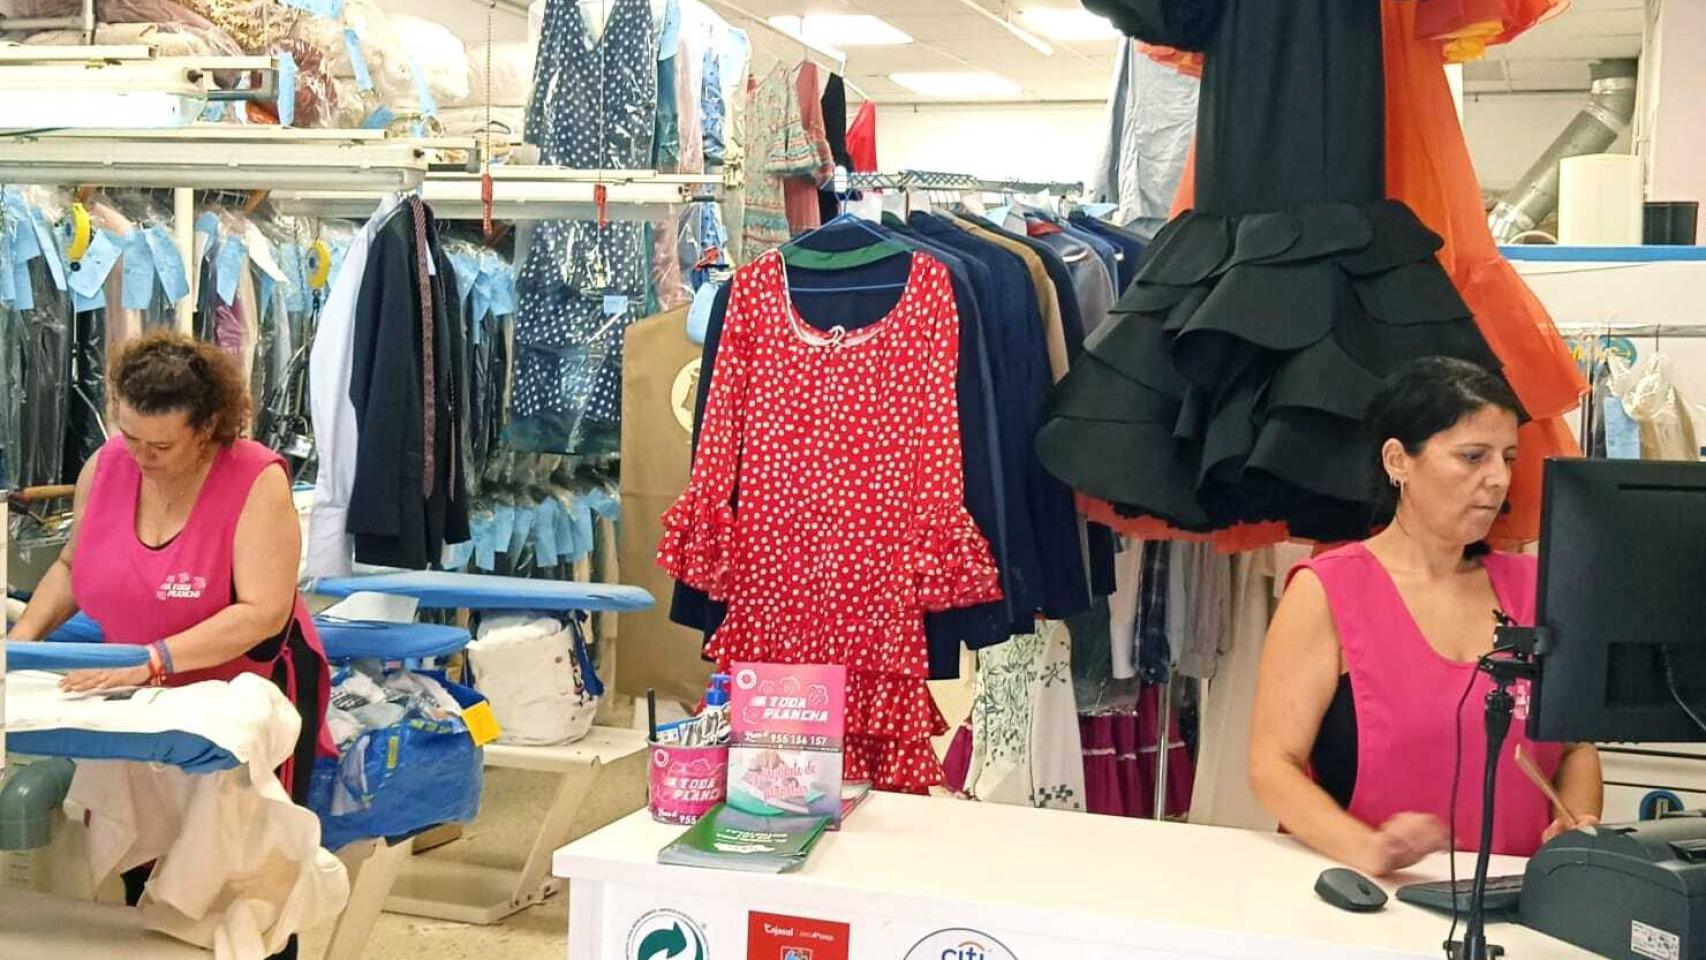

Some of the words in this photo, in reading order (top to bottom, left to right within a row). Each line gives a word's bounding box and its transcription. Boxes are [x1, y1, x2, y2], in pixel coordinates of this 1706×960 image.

[768, 696, 807, 708] TODA
[763, 708, 829, 722] PLANCHA
[770, 733, 788, 743] 955
[810, 736, 827, 746] 157
